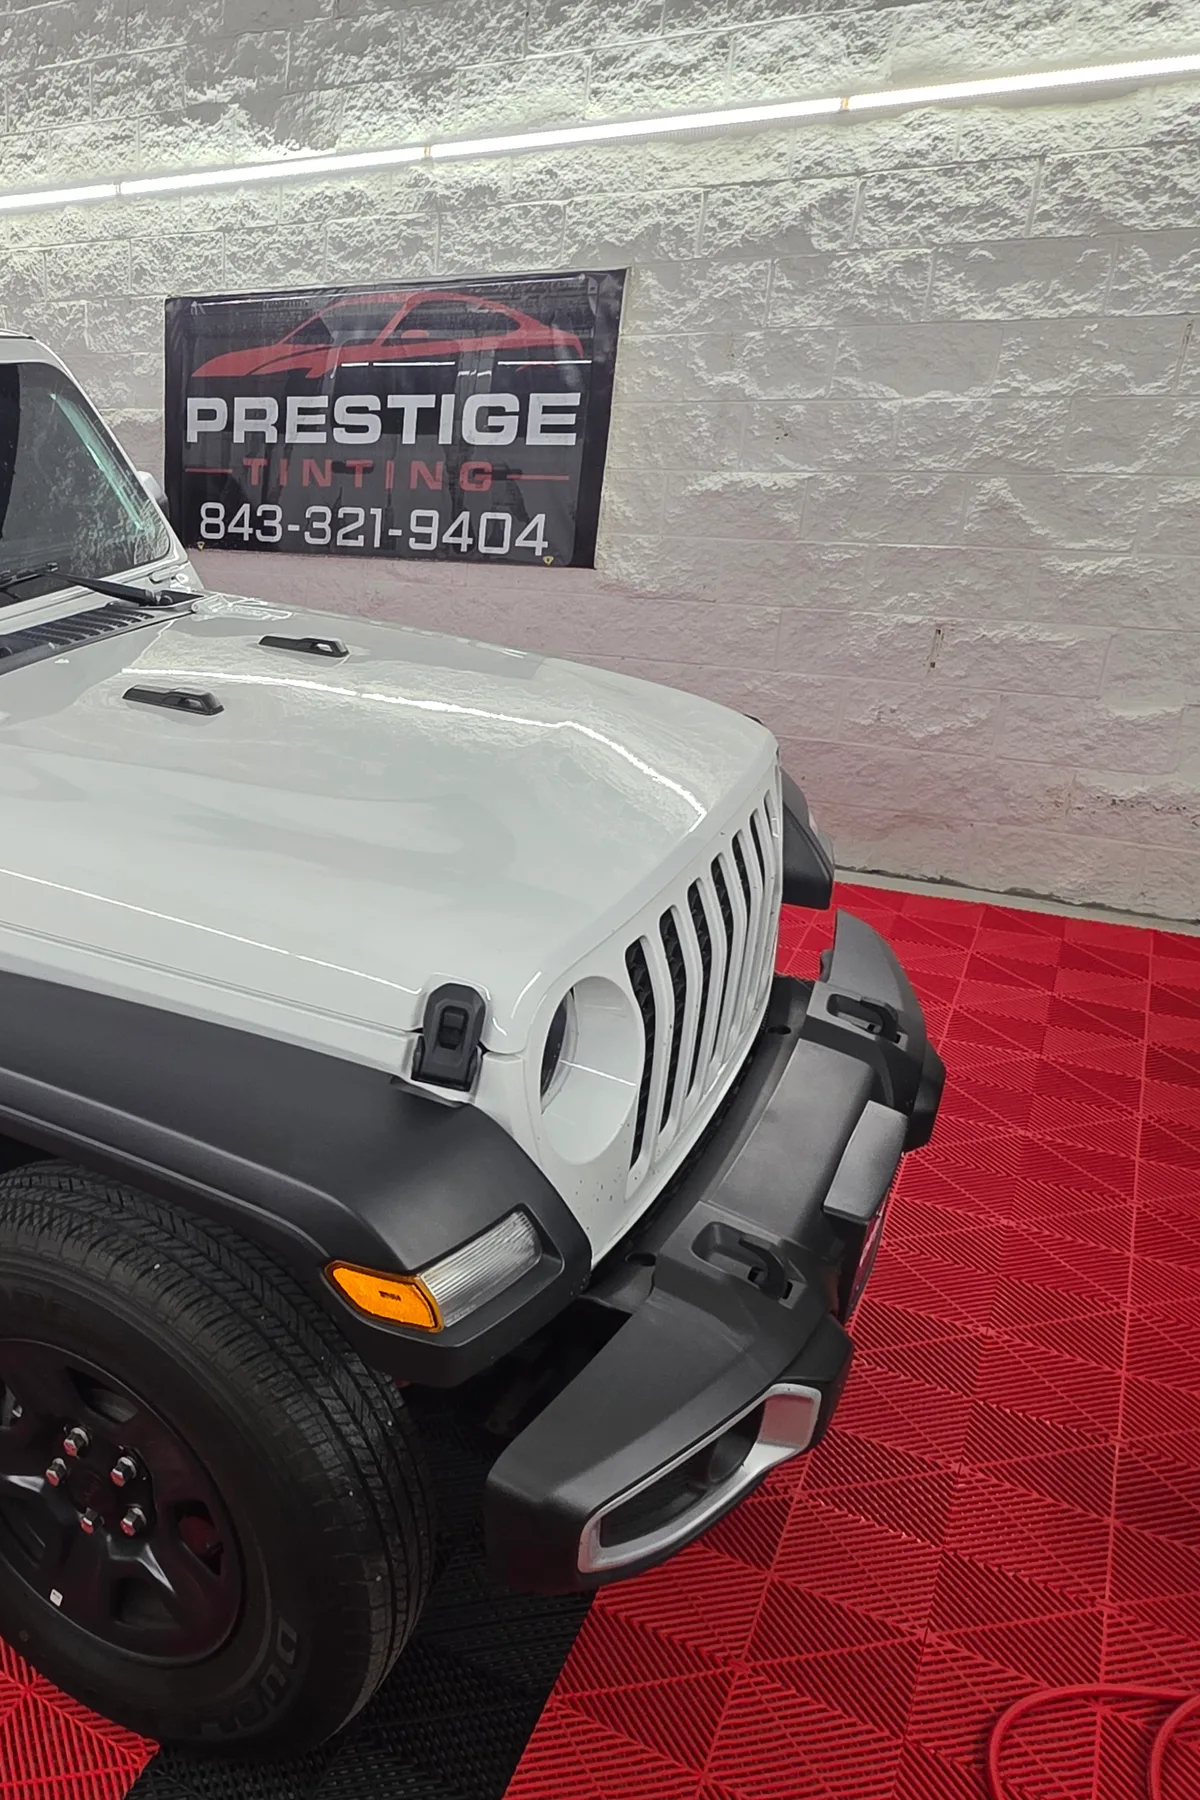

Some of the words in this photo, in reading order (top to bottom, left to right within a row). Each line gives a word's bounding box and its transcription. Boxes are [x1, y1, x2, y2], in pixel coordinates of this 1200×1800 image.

[186, 392, 581, 446] PRESTIGE
[242, 457, 493, 492] TINTING
[199, 501, 549, 557] 843-321-9404
